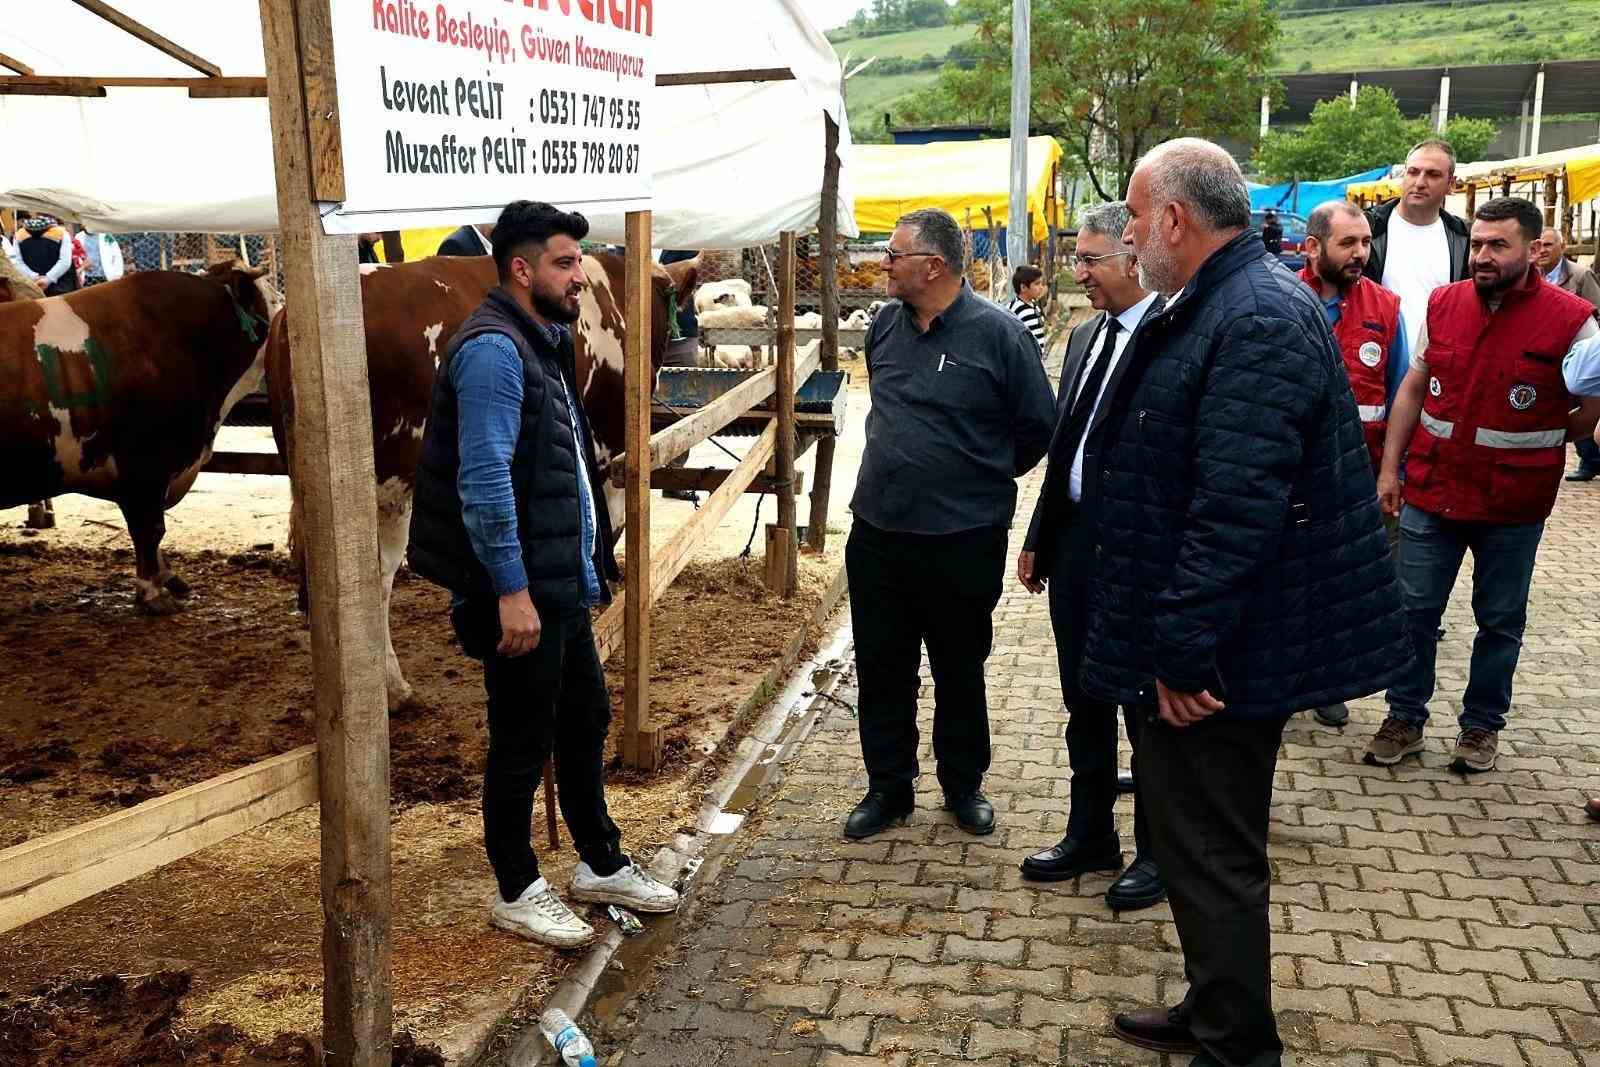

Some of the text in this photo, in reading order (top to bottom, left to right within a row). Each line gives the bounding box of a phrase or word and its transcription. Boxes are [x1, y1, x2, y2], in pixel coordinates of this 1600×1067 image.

[373, 0, 430, 39] Kalite
[436, 4, 516, 65] Besleyip,
[522, 18, 570, 65] Güven
[576, 35, 644, 82] Kazanıyoruz
[381, 65, 450, 117] Levent
[455, 69, 504, 120] PELİT
[540, 88, 577, 126] 0531
[583, 94, 606, 128] 747
[610, 98, 624, 129] 95
[627, 100, 641, 131] 55
[386, 130, 477, 174] Muzaffer
[482, 127, 527, 174] PELİT
[543, 140, 577, 174] 0535
[583, 142, 605, 174] 798
[609, 143, 623, 174] 20
[626, 144, 640, 174] 87
